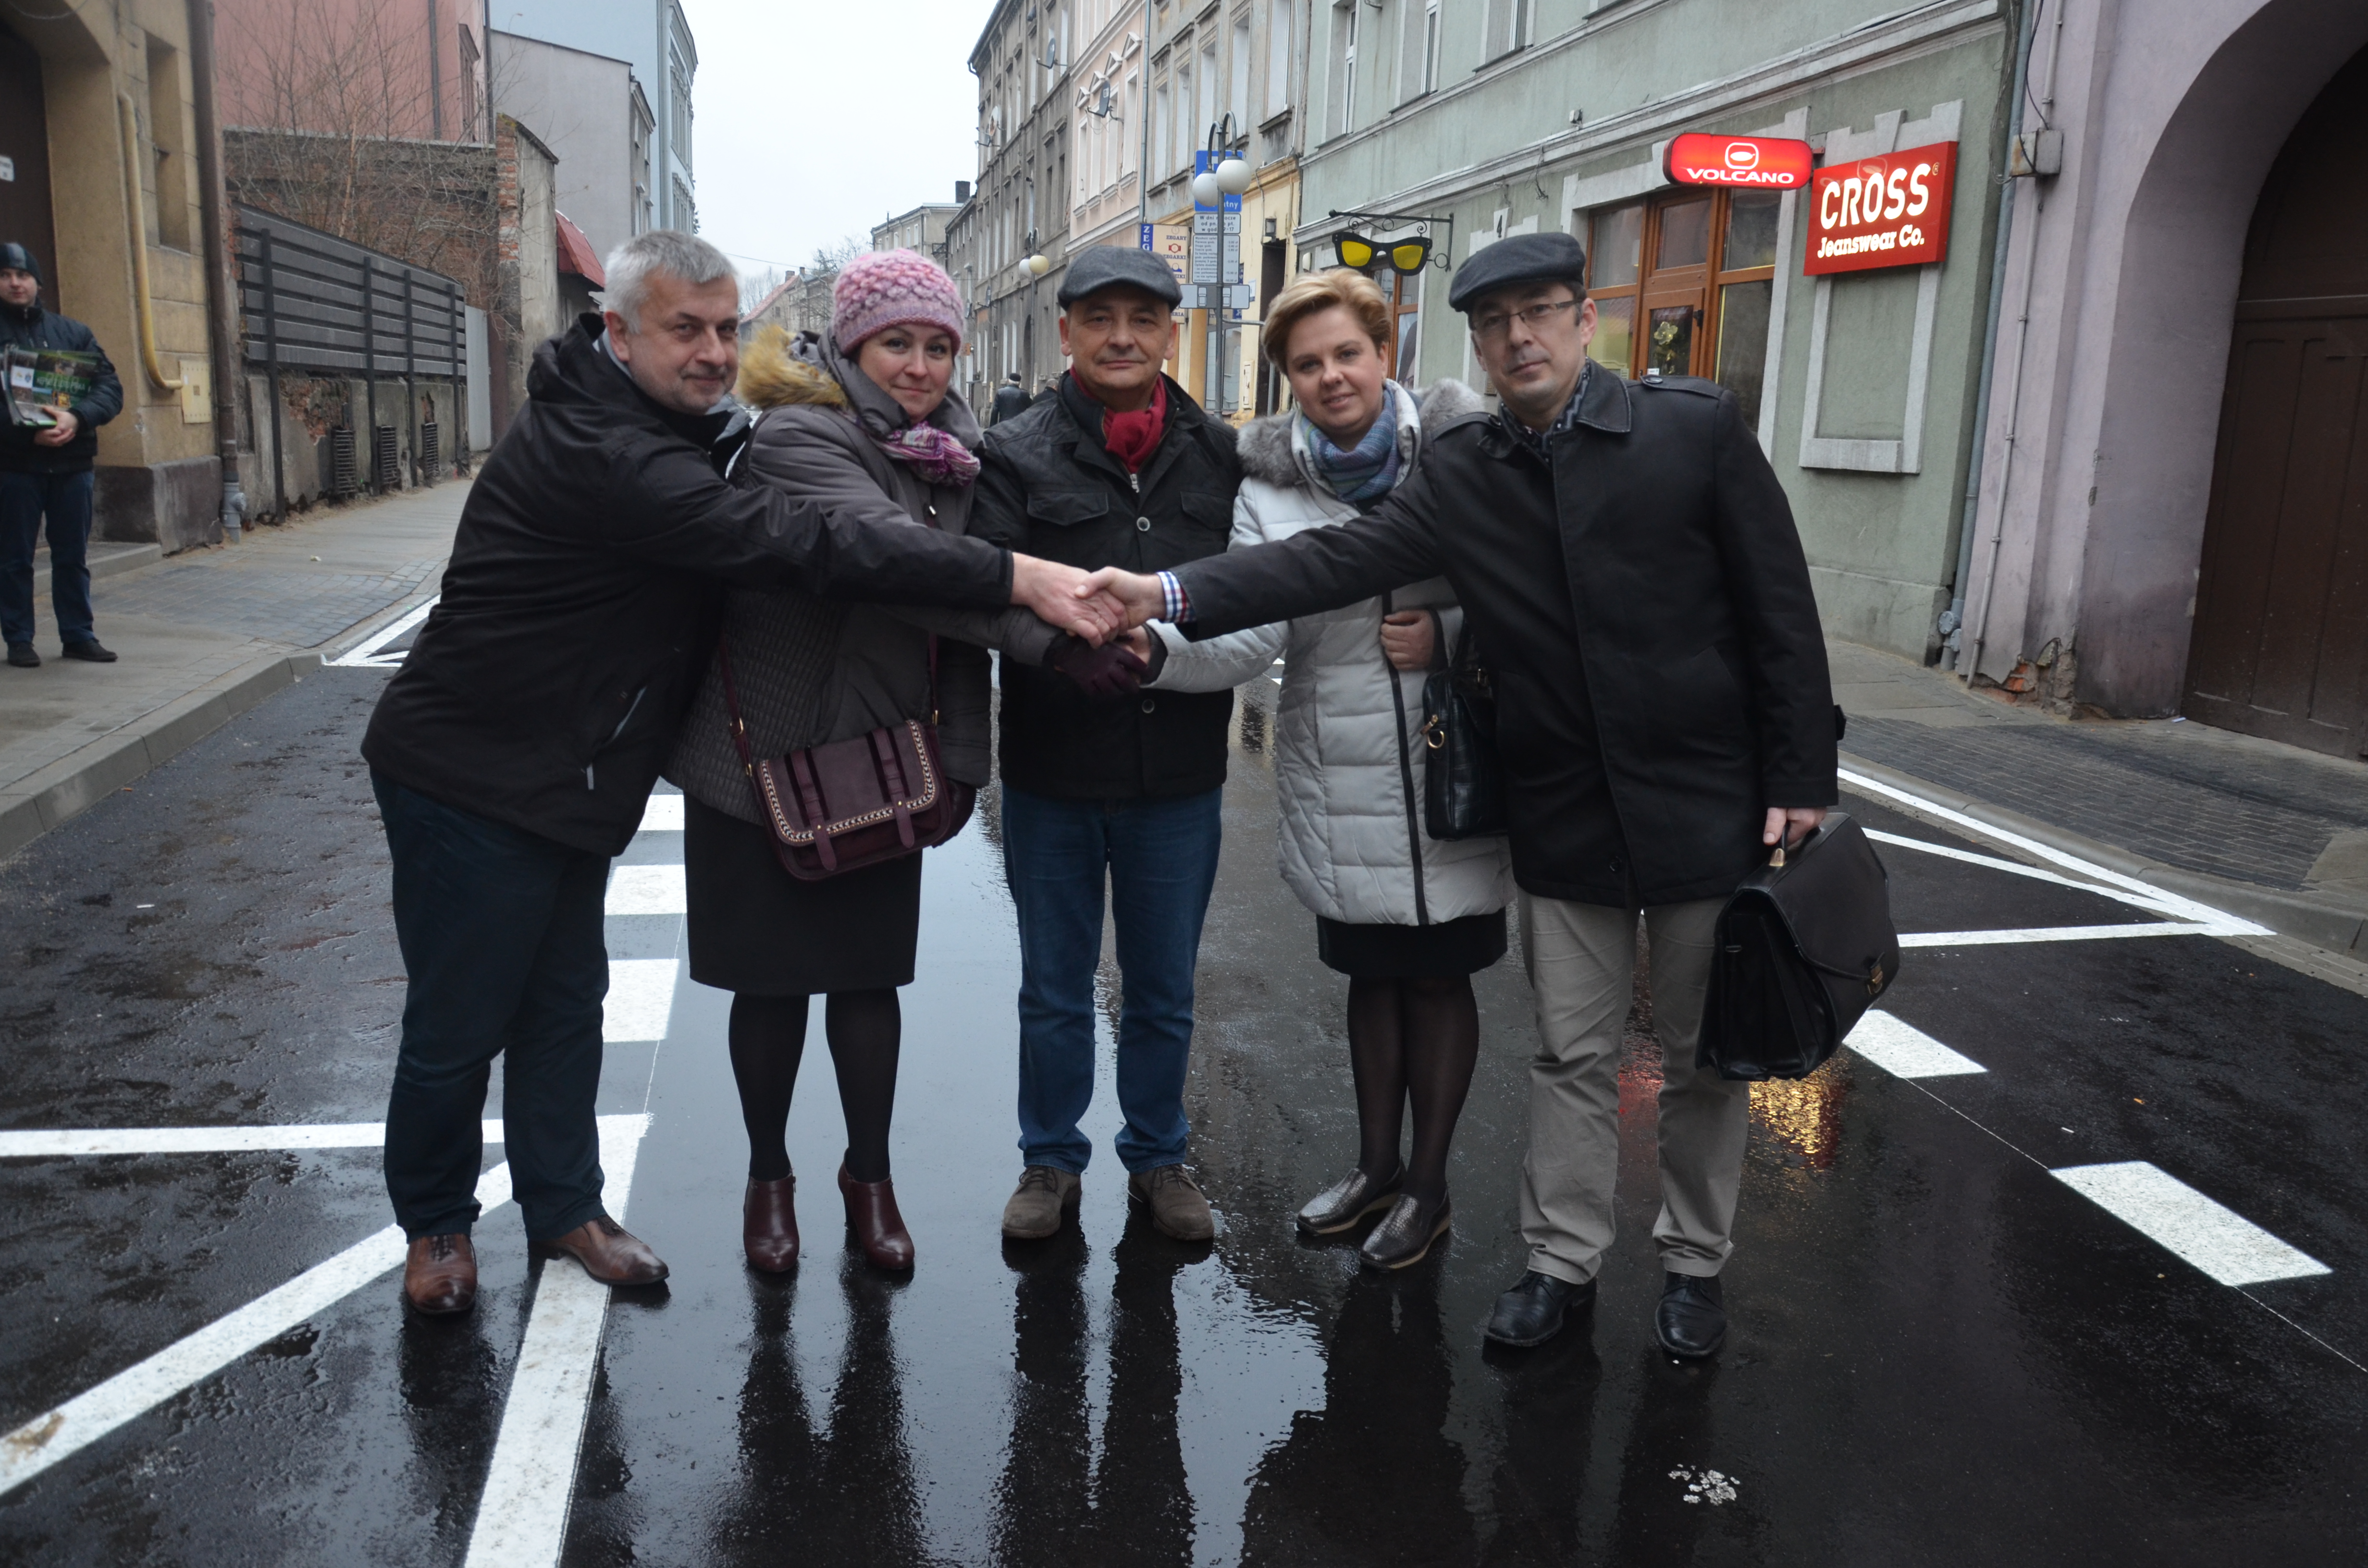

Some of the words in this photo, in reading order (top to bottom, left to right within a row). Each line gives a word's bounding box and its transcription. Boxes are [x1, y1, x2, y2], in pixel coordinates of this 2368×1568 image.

[1686, 168, 1795, 184] VOLCANO
[1820, 163, 1931, 230] CROSS
[1142, 226, 1150, 251] ZEG
[1817, 231, 1898, 258] Jeanswear
[1899, 224, 1924, 248] Co.
